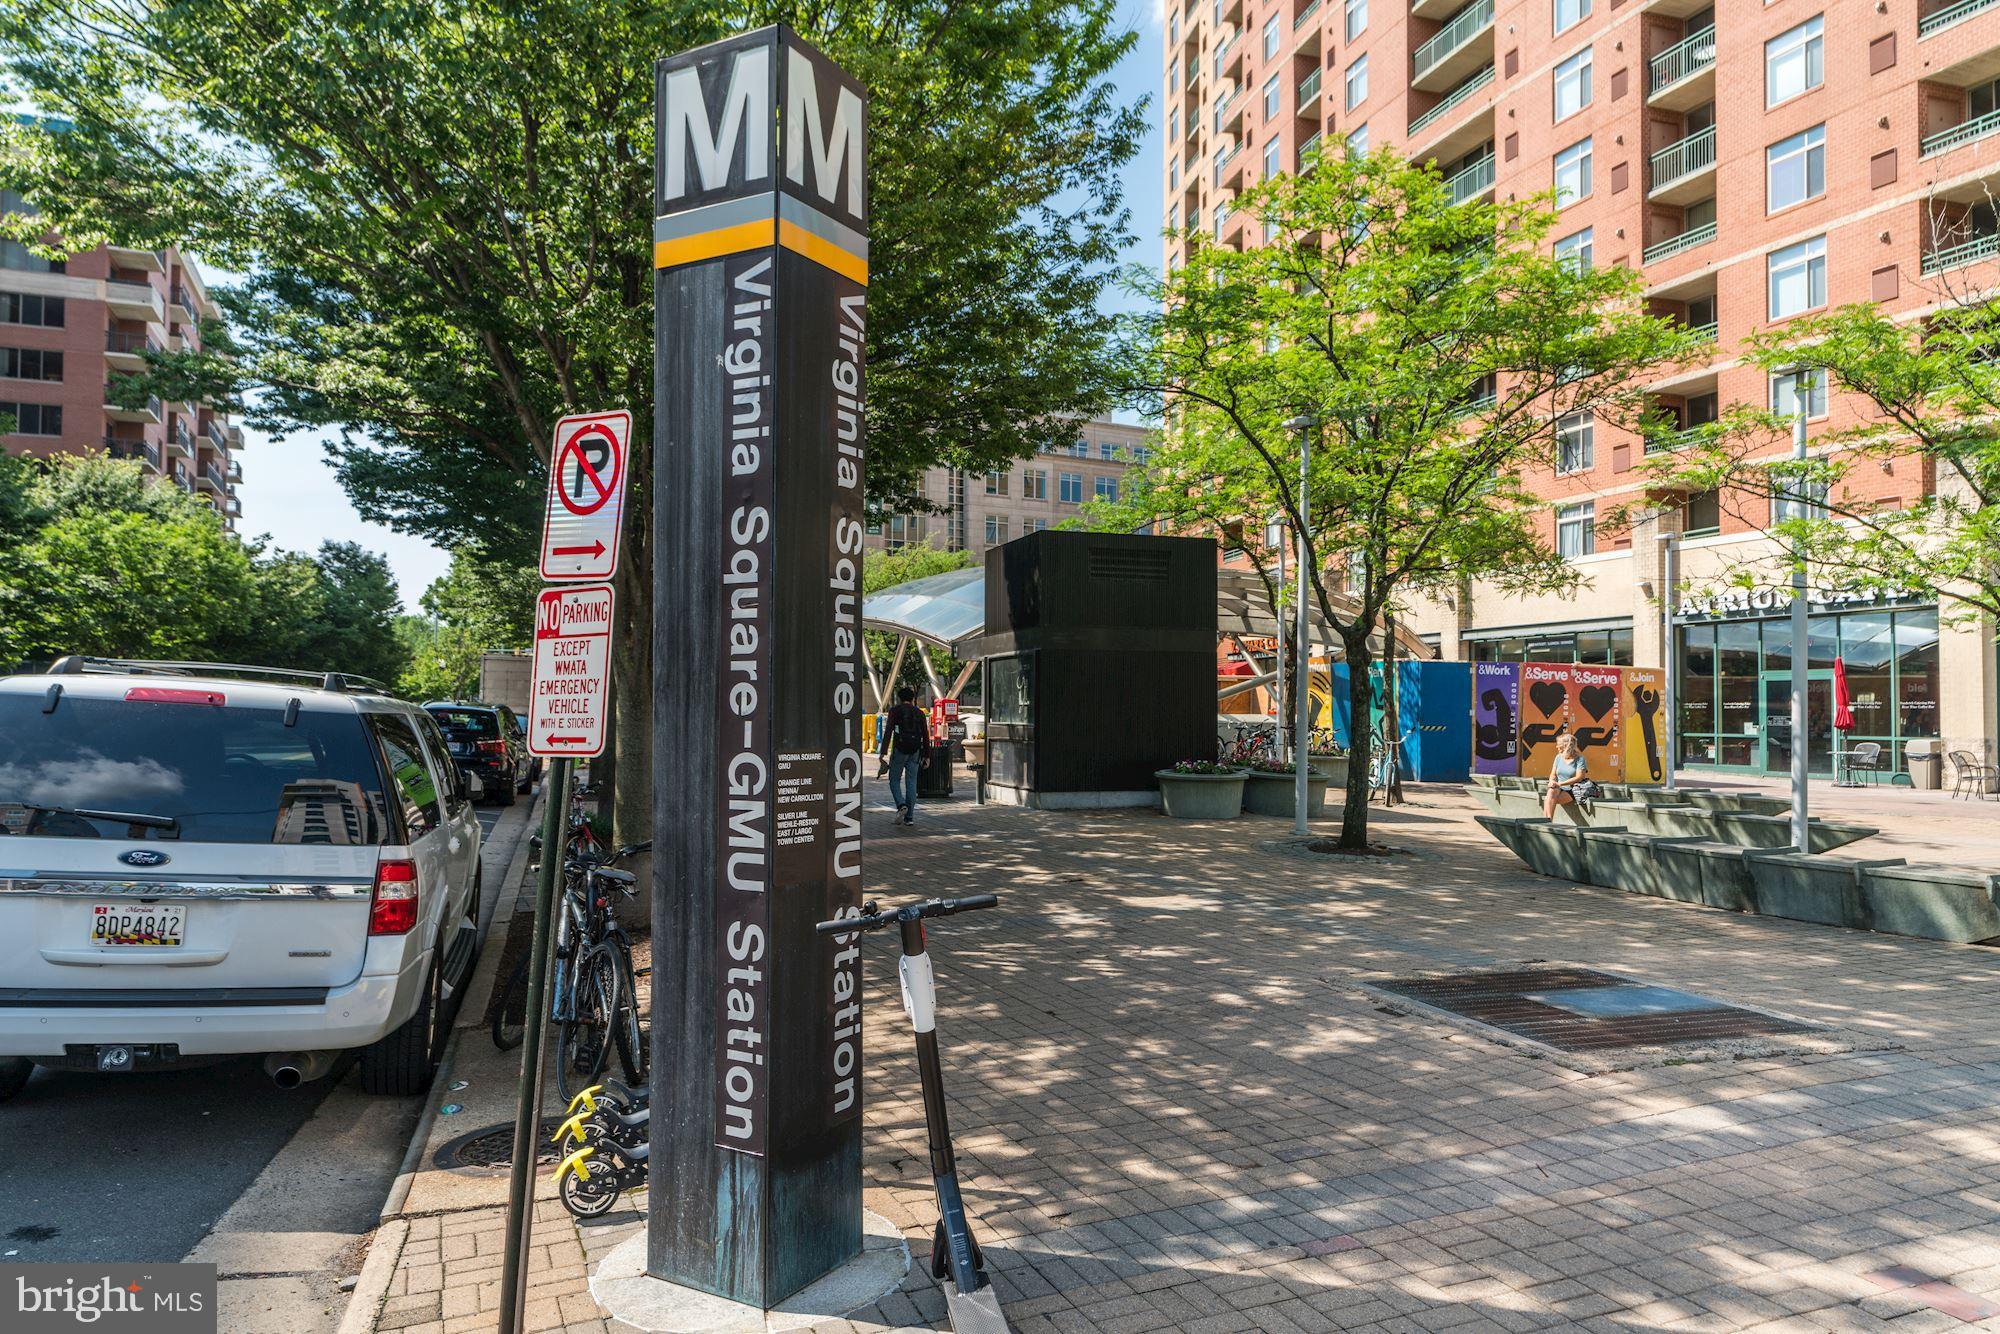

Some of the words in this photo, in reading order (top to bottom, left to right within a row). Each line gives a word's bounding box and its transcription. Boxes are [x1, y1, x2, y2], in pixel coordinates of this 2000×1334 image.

[665, 44, 769, 201] M
[786, 45, 863, 220] M
[725, 256, 772, 477] Virginia
[832, 295, 865, 489] Virginia
[538, 599, 561, 631] NO
[563, 601, 608, 624] PARKING
[553, 639, 591, 657] EXCEPT
[555, 659, 587, 676] WMATA
[1478, 664, 1511, 676] &Work
[1525, 666, 1569, 681] &Serve
[1574, 670, 1618, 685] &Serve
[1629, 671, 1655, 683] &Join
[539, 678, 600, 696] EMERGENCY
[548, 698, 590, 715] VEHICLE
[540, 718, 557, 729] WITH
[558, 718, 565, 729] E
[567, 717, 595, 729] STICKER
[778, 754, 801, 762] VIRGINIA
[778, 787, 799, 795] VIENNA/
[778, 796, 790, 804] NEW
[790, 793, 824, 803] CARROLLTON
[777, 812, 795, 820] SILVER
[777, 818, 819, 829] WIEHLE-RESTON
[777, 830, 791, 838] EAST
[795, 827, 812, 835] LARGO
[777, 837, 793, 846] TOWN
[794, 835, 814, 844] CENTER
[128, 851, 158, 864] Ford
[96, 916, 179, 937] 8DP4842
[725, 920, 765, 1140] Station
